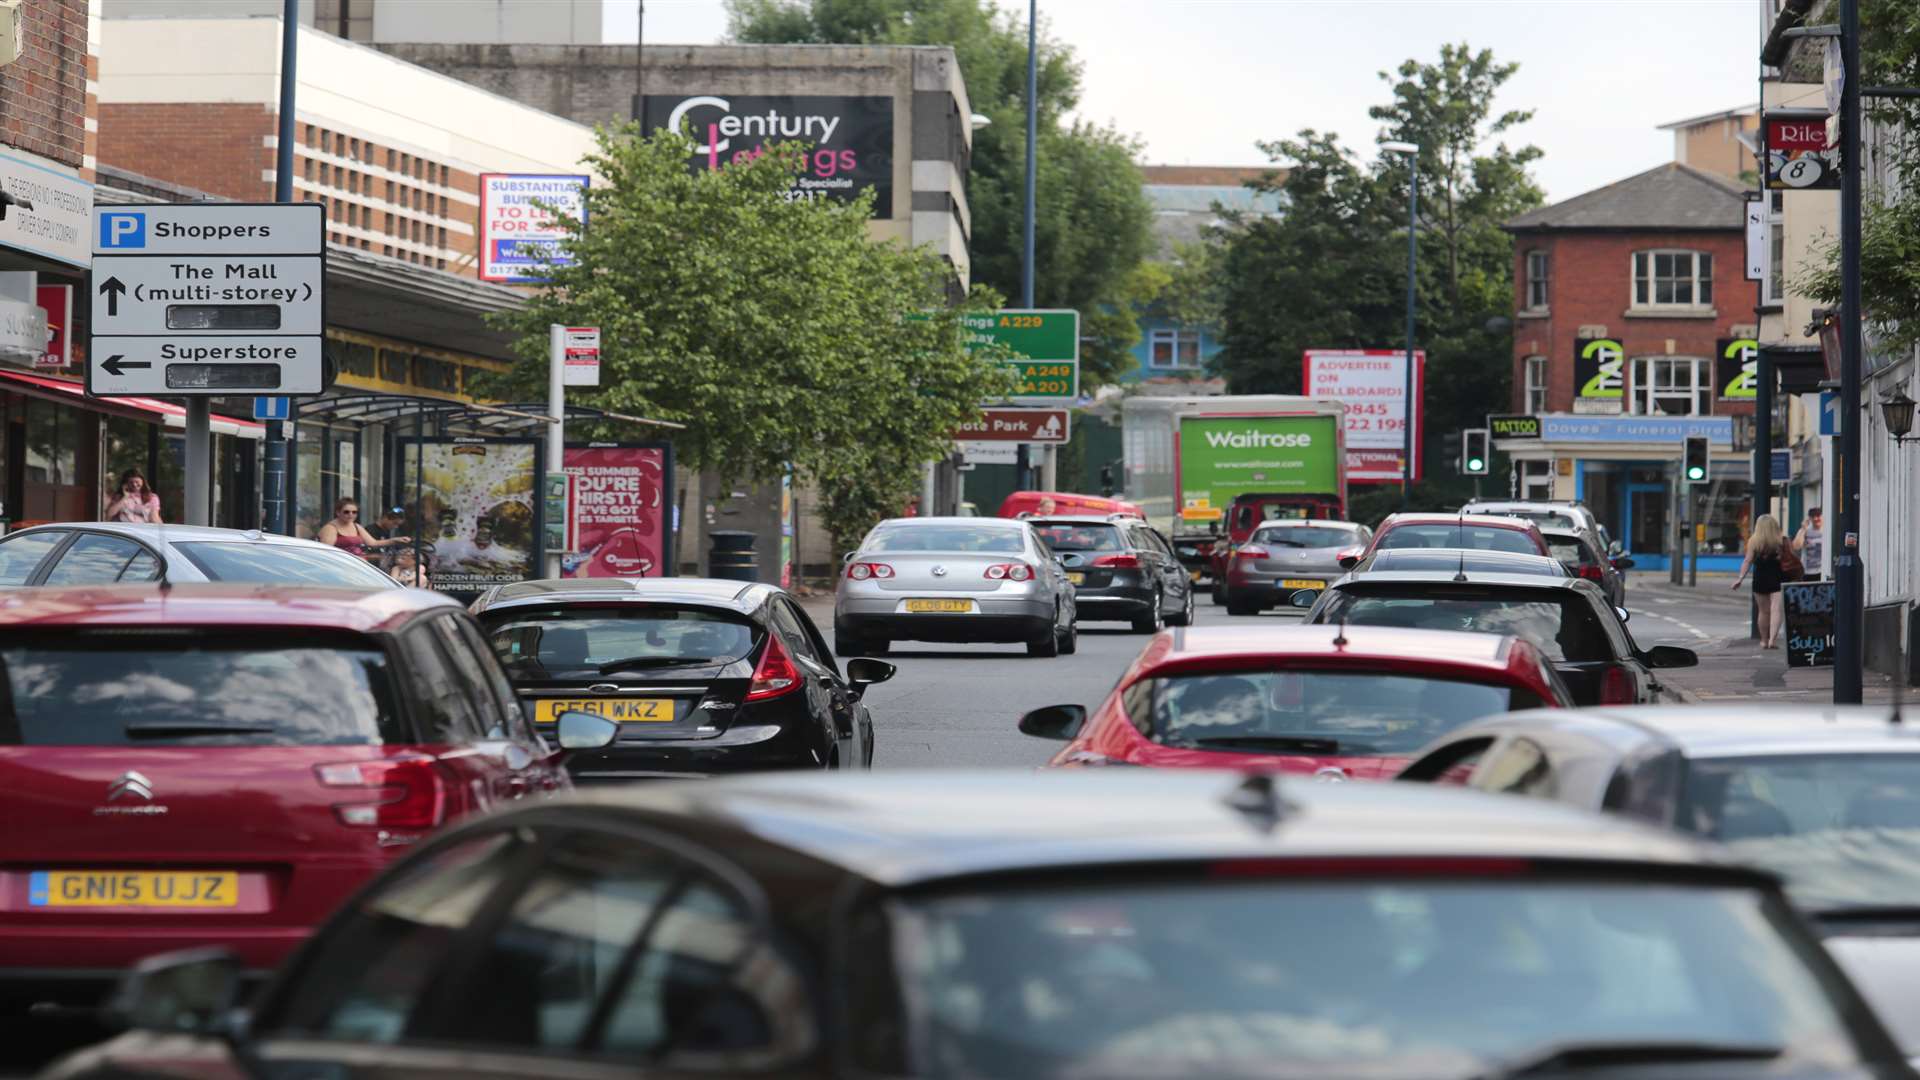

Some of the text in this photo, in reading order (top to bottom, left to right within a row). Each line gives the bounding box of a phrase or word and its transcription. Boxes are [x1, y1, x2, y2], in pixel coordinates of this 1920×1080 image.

[1790, 161, 1806, 178] 8
[503, 195, 569, 205] BUIDING
[498, 207, 522, 218] TO
[111, 216, 270, 246] P Shoppers
[491, 221, 528, 232] FOR
[171, 264, 277, 279] The Mall
[134, 283, 313, 302] (multi-storey)
[161, 344, 297, 361] Superstore
[1318, 362, 1392, 370] ADVERTISE
[1317, 374, 1339, 382] ON
[1317, 387, 1402, 396] BILLBOARDS
[1344, 404, 1388, 415] 0845
[957, 420, 1028, 431] ote Park
[1493, 420, 1537, 433] TATTOO
[1617, 424, 1682, 434] Funeral
[1205, 430, 1311, 448] Waitrose
[587, 467, 643, 476] SUMMER.
[579, 476, 640, 491] OU'RE
[578, 491, 643, 505] HIRSTY.
[579, 505, 639, 515] E'VE GOT
[612, 702, 658, 717] WKZ
[62, 876, 224, 900] GN15 UJZ
